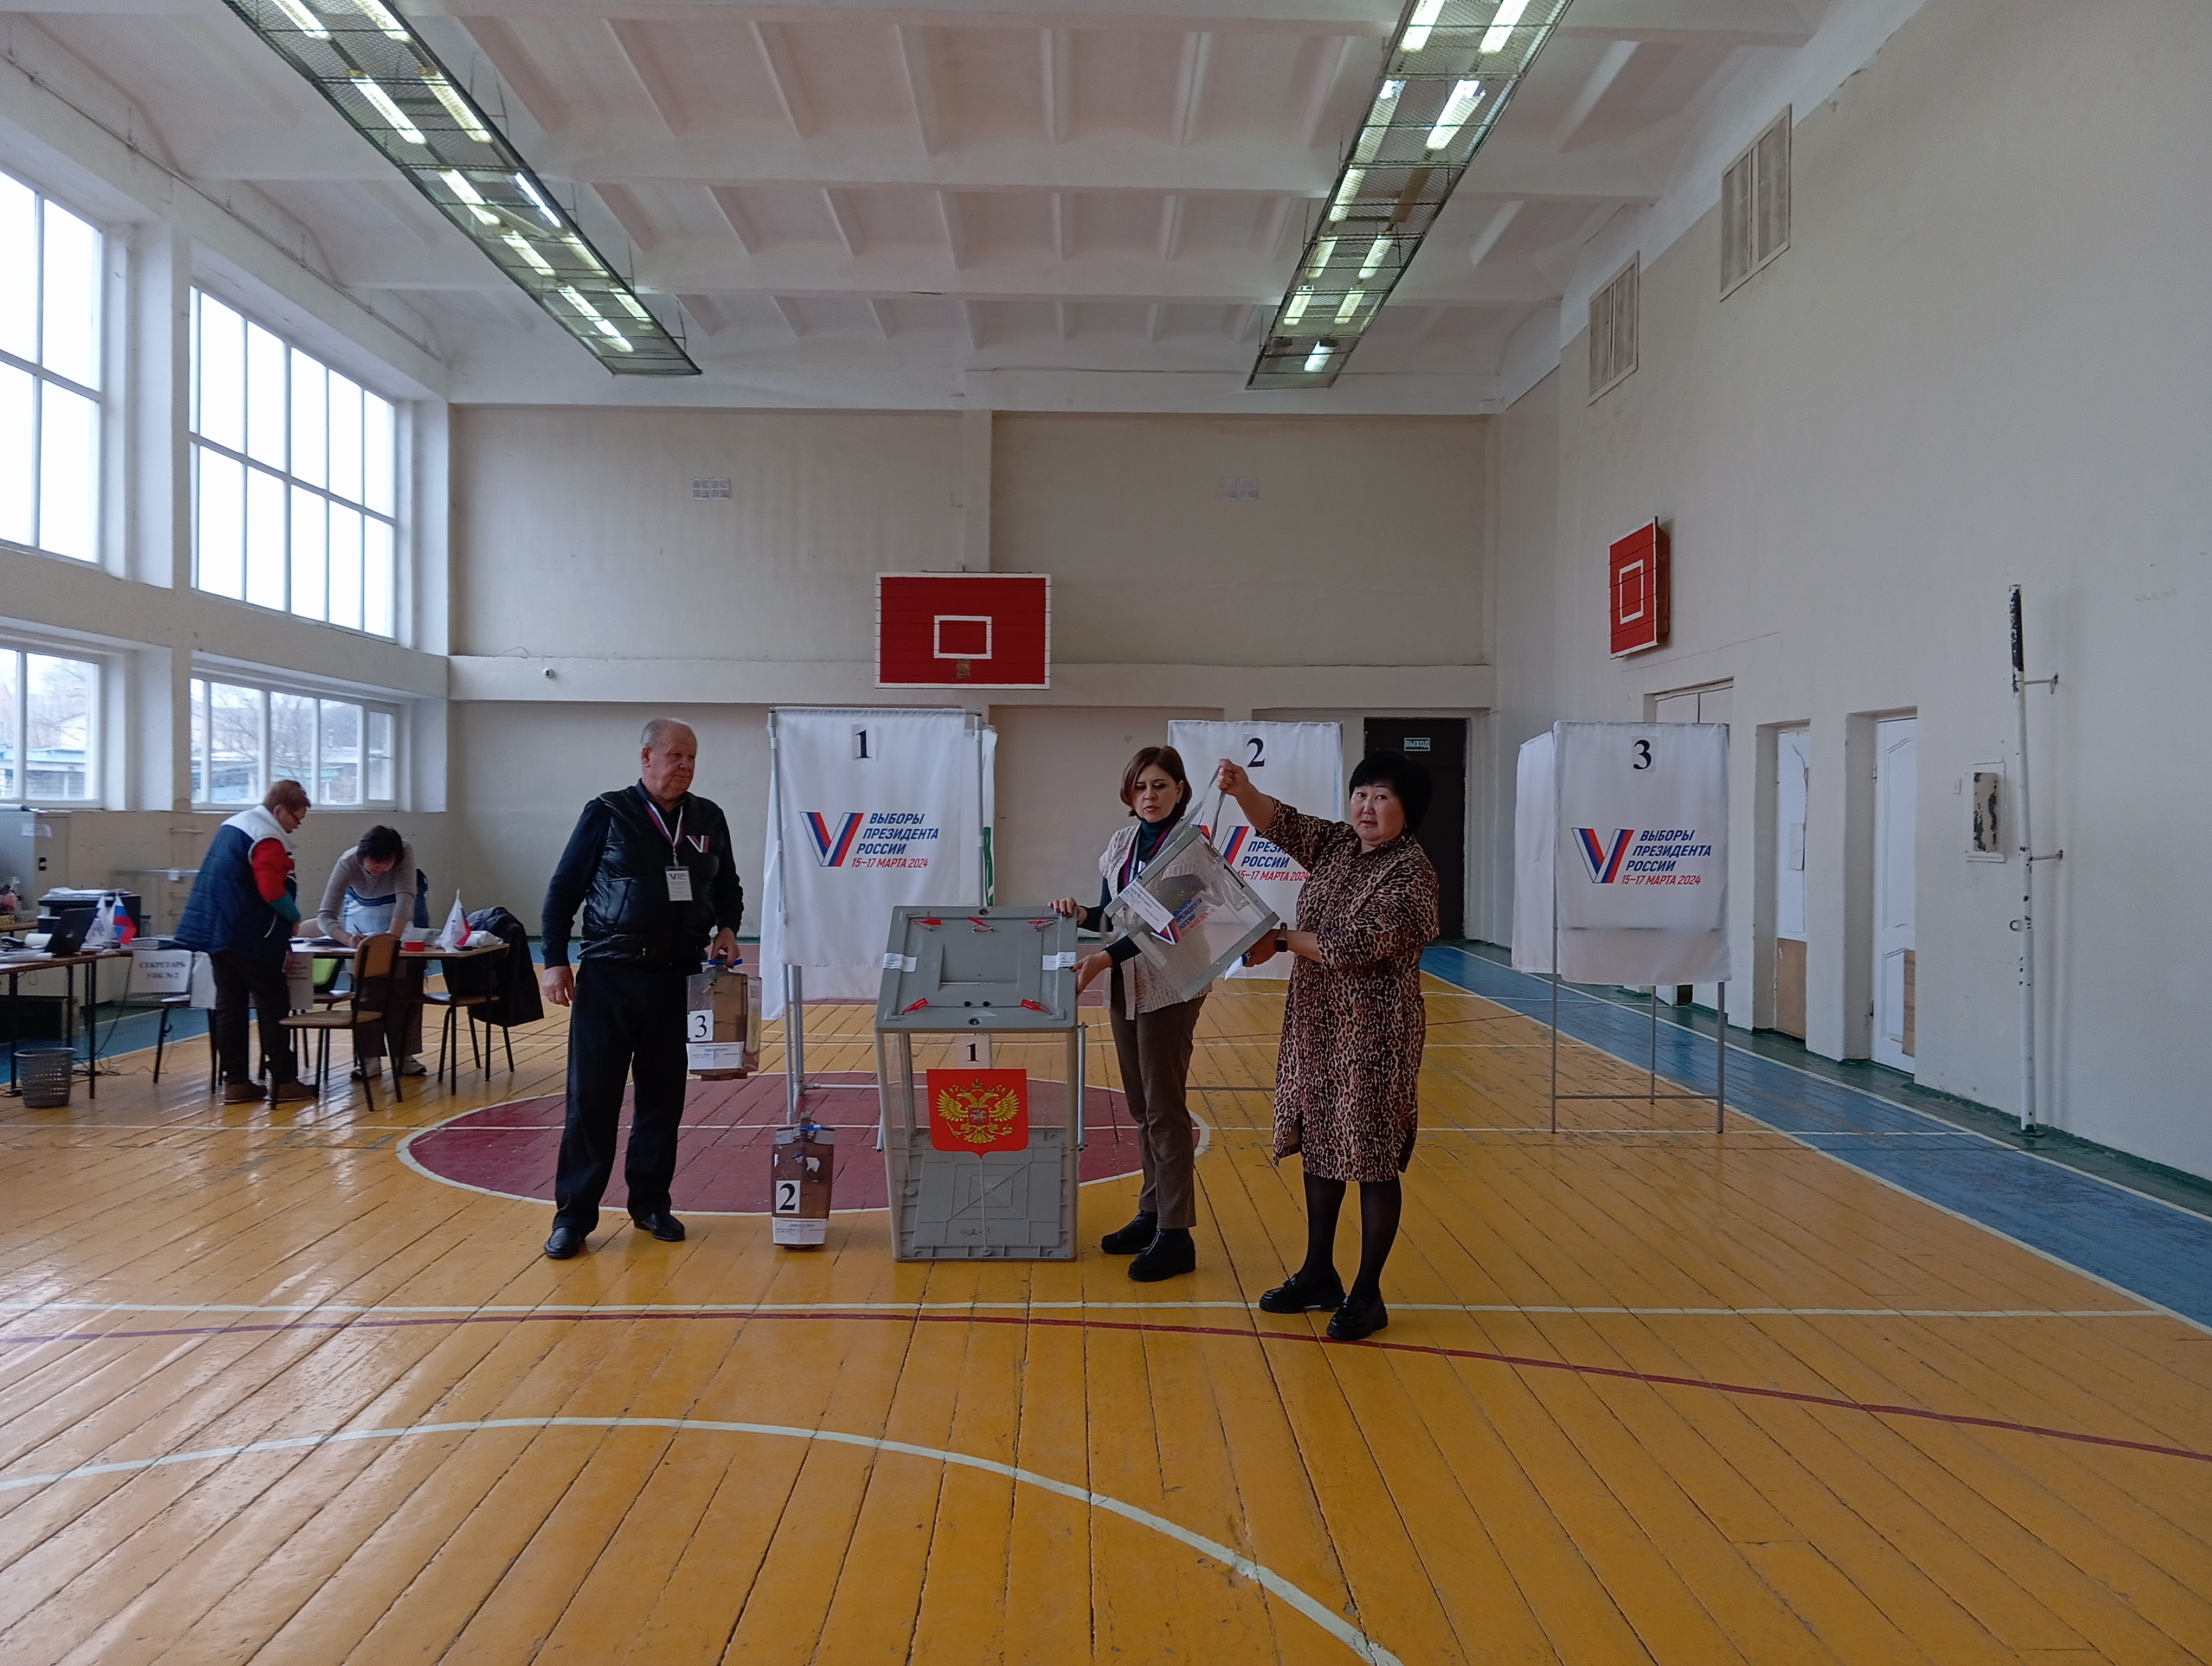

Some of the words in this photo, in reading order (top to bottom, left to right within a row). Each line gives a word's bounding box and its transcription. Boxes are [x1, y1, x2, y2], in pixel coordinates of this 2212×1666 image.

[855, 729, 872, 759] 1
[1405, 740, 1429, 749] ВЫХОД
[1246, 738, 1265, 768] 2
[1633, 739, 1652, 770] 3
[869, 813, 925, 824] ВЫБОРЫ
[863, 828, 939, 841] ПРЕЗИДЕНТА
[1639, 830, 1695, 841] ВЫБОРЫ
[856, 843, 907, 854] РОССИИ
[1632, 845, 1712, 857] ПРЕЗИДЕНТА
[876, 858, 906, 868] МАРТА
[908, 858, 929, 868] 2024
[1240, 856, 1290, 868] РОССИИ
[1625, 860, 1677, 872] РОССИИ
[1259, 871, 1289, 881] МАРТА
[1289, 872, 1310, 881] 2024
[1645, 875, 1675, 885] МАРТА
[1677, 875, 1701, 885] 2024
[695, 1015, 707, 1038] 3
[966, 1043, 980, 1062] 1
[779, 1183, 796, 1210] 2
